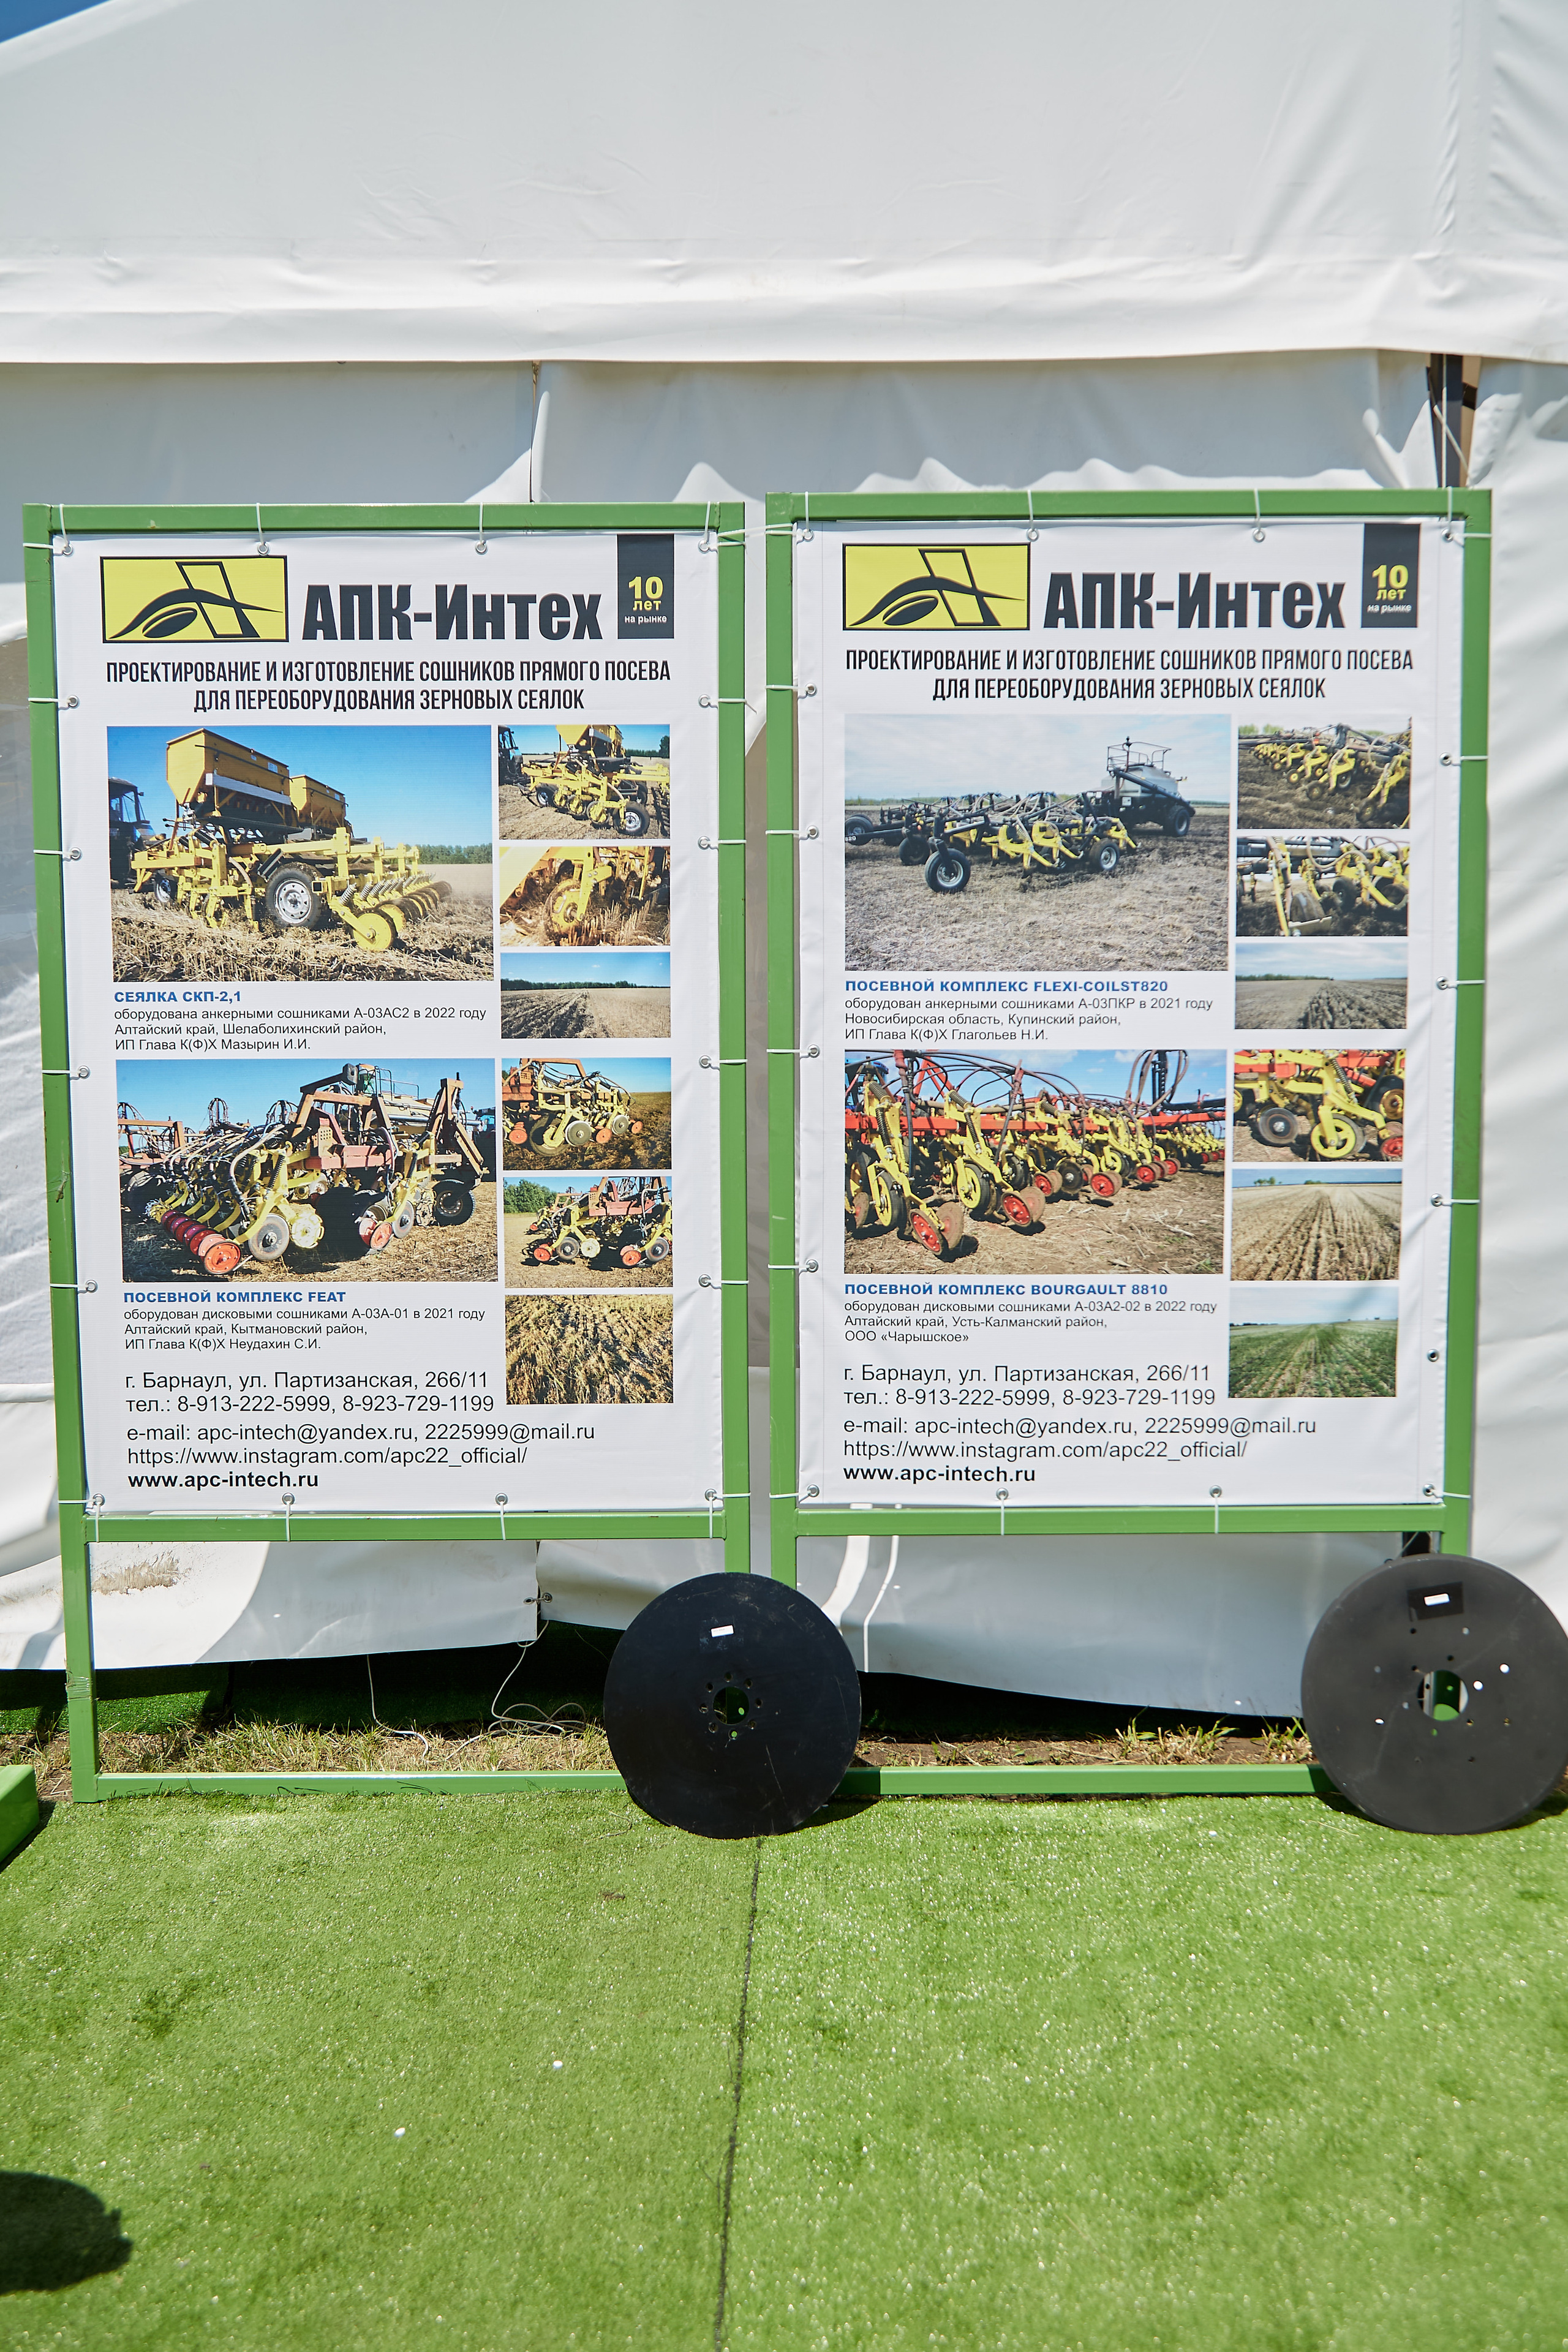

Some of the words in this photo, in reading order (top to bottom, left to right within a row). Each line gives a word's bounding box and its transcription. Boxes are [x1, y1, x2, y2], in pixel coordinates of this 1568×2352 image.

[1372, 564, 1408, 589] 10
[628, 576, 663, 599] 10
[1376, 589, 1406, 601] лет
[633, 600, 662, 611] лет
[1042, 571, 1346, 629] АПК-Интех
[301, 584, 603, 641] АПК-Интех
[1367, 605, 1380, 613] на
[1381, 605, 1412, 614] рынке
[638, 616, 668, 625] рынке
[846, 649, 1001, 671] ПРОЕКТИРОВАНИЕ
[1006, 649, 1017, 671] И
[1022, 649, 1156, 671] ИЗГОТОВЛЕНИЕ
[1160, 649, 1257, 671] СОШНИКОВ
[1261, 649, 1342, 670] ПРЯМОГО
[1347, 649, 1414, 670] ПОСЕВА
[106, 660, 262, 683] ПРОЕКТИРОВАНИЕ
[266, 660, 277, 682] И
[282, 660, 415, 682] ИЗГОТОВЛЕНИЕ
[419, 660, 515, 682] СОШНИКОВ
[519, 660, 600, 682] ПРЯМОГО
[605, 660, 671, 681] ПОСЕВА
[932, 677, 970, 701] ДЛЯ
[974, 677, 1155, 701] ПЕРЕОБОРУДОВАНИЯ
[1160, 677, 1254, 699] ЗЕРНОВЫХ
[1259, 677, 1326, 698] СЕЯЛОК
[193, 689, 230, 713] ДЛЯ
[235, 688, 415, 712] ПЕРЕОБОРУДОВАНИЯ
[420, 688, 513, 710] ЗЕРНОВЫХ
[518, 688, 585, 710] СЕЯЛОК
[845, 978, 935, 992] ПОСЕВНОЙ
[940, 981, 1028, 992] КОМПЛЕКС
[1033, 981, 1168, 992] FLEXI-COILST820
[114, 991, 178, 1003] СЕЯЛКА
[182, 990, 241, 1005] СКП-2,1
[845, 997, 921, 1011] оборудован
[925, 1000, 997, 1012] анкерными
[1001, 1000, 1074, 1009] сошниками
[1077, 997, 1136, 1009] А-03ПКР
[1139, 1000, 1147, 1009] в
[1150, 997, 1180, 1009] 2021
[1185, 1000, 1213, 1011] году
[114, 1008, 198, 1022] оборудована
[202, 1010, 273, 1022] анкерными
[277, 1010, 350, 1019] сошниками
[353, 1007, 410, 1019] А-03АС2
[413, 1009, 421, 1019] в
[424, 1007, 456, 1019] 2022
[459, 1009, 486, 1021] году
[845, 1012, 944, 1027] Новосибирская
[948, 1013, 1003, 1026] область,
[1008, 1013, 1074, 1027] Купинский
[1079, 1013, 1121, 1027] район,
[114, 1023, 182, 1035] Алтайский
[186, 1023, 219, 1037] край,
[223, 1023, 341, 1035] Шелаболихинский
[344, 1023, 386, 1036] район,
[845, 1028, 864, 1039] ИП
[869, 1028, 907, 1040] Глава
[911, 1028, 948, 1043] К(Ф)Х
[952, 1028, 1017, 1040] Глагольев
[1021, 1028, 1048, 1040] Н.И.
[115, 1039, 135, 1050] ИП
[139, 1039, 176, 1050] Глава
[180, 1038, 217, 1053] К(Ф)Х
[221, 1038, 279, 1052] Мазырин
[284, 1038, 311, 1049] И.И.
[845, 1281, 933, 1295] ПОСЕВНОЙ
[938, 1284, 1026, 1295] КОМПЛЕКС
[1031, 1284, 1127, 1295] BOURGAULT
[1131, 1284, 1167, 1295] 8810
[123, 1289, 211, 1303] ПОСЕВНОЙ
[216, 1291, 303, 1303] КОМПЛЕКС
[307, 1291, 347, 1302] FEAT
[844, 1300, 919, 1314] оборудован
[922, 1303, 994, 1314] дисковыми
[998, 1303, 1071, 1312] сошниками
[1074, 1300, 1140, 1312] А-03А2-02
[1144, 1303, 1152, 1311] в
[1155, 1300, 1186, 1311] 2022
[1189, 1303, 1217, 1314] году
[124, 1308, 198, 1322] оборудован
[202, 1311, 273, 1321] дисковыми
[276, 1310, 348, 1319] сошниками
[351, 1308, 408, 1319] А-03А-01
[413, 1310, 421, 1319] в
[424, 1308, 453, 1319] 2021
[458, 1310, 486, 1322] году
[844, 1314, 911, 1327] Алтайский
[915, 1316, 948, 1329] край,
[952, 1316, 1061, 1327] Усть-Калманский
[1065, 1316, 1107, 1330] район,
[124, 1323, 191, 1335] Алтайский
[195, 1323, 227, 1337] край,
[231, 1323, 322, 1334] Кытмановский
[326, 1323, 368, 1336] район,
[845, 1330, 876, 1341] ООО
[881, 1330, 969, 1344] «Чарышское»
[125, 1338, 145, 1349] ИП
[148, 1338, 186, 1349] Глава
[189, 1338, 226, 1352] К(Ф)Х
[229, 1338, 290, 1352] Неудахин
[294, 1338, 321, 1349] С.И.
[126, 1376, 135, 1389] г.
[143, 1371, 232, 1392] Барнаул,
[238, 1375, 267, 1392] ул.
[274, 1371, 418, 1392] Партизанская,
[425, 1371, 486, 1388] 266/11
[844, 1368, 854, 1381] г.
[862, 1364, 951, 1385] Барнаул,
[958, 1369, 986, 1386] ул.
[995, 1365, 1139, 1386] Партизанская,
[1146, 1364, 1208, 1381] 266/11
[125, 1400, 170, 1412] тел.:
[178, 1395, 336, 1414] 8-913-222-5999,
[342, 1395, 494, 1412] 8-923-729-1199
[843, 1392, 888, 1405] тел.:
[895, 1388, 1055, 1408] 8-913-222-5999,
[1063, 1389, 1215, 1406] 8-923-729-1199
[127, 1423, 190, 1441] e-mail:
[197, 1423, 418, 1444] apc-intech@yandex.ru,
[424, 1422, 595, 1444] 2225999@mail.ru
[843, 1417, 907, 1433] e-mail:
[914, 1417, 1137, 1439] apc-intech@yandex.ru,
[1145, 1417, 1316, 1438] 2225999@mail.ru
[128, 1446, 528, 1468] https://www.instagram.com/apc22_official/
[844, 1439, 1248, 1463] https://www.instagram.com/apc22_official/
[127, 1471, 318, 1491] www.apc-intech.ru
[843, 1464, 1035, 1484] www.apc-intech.ru
